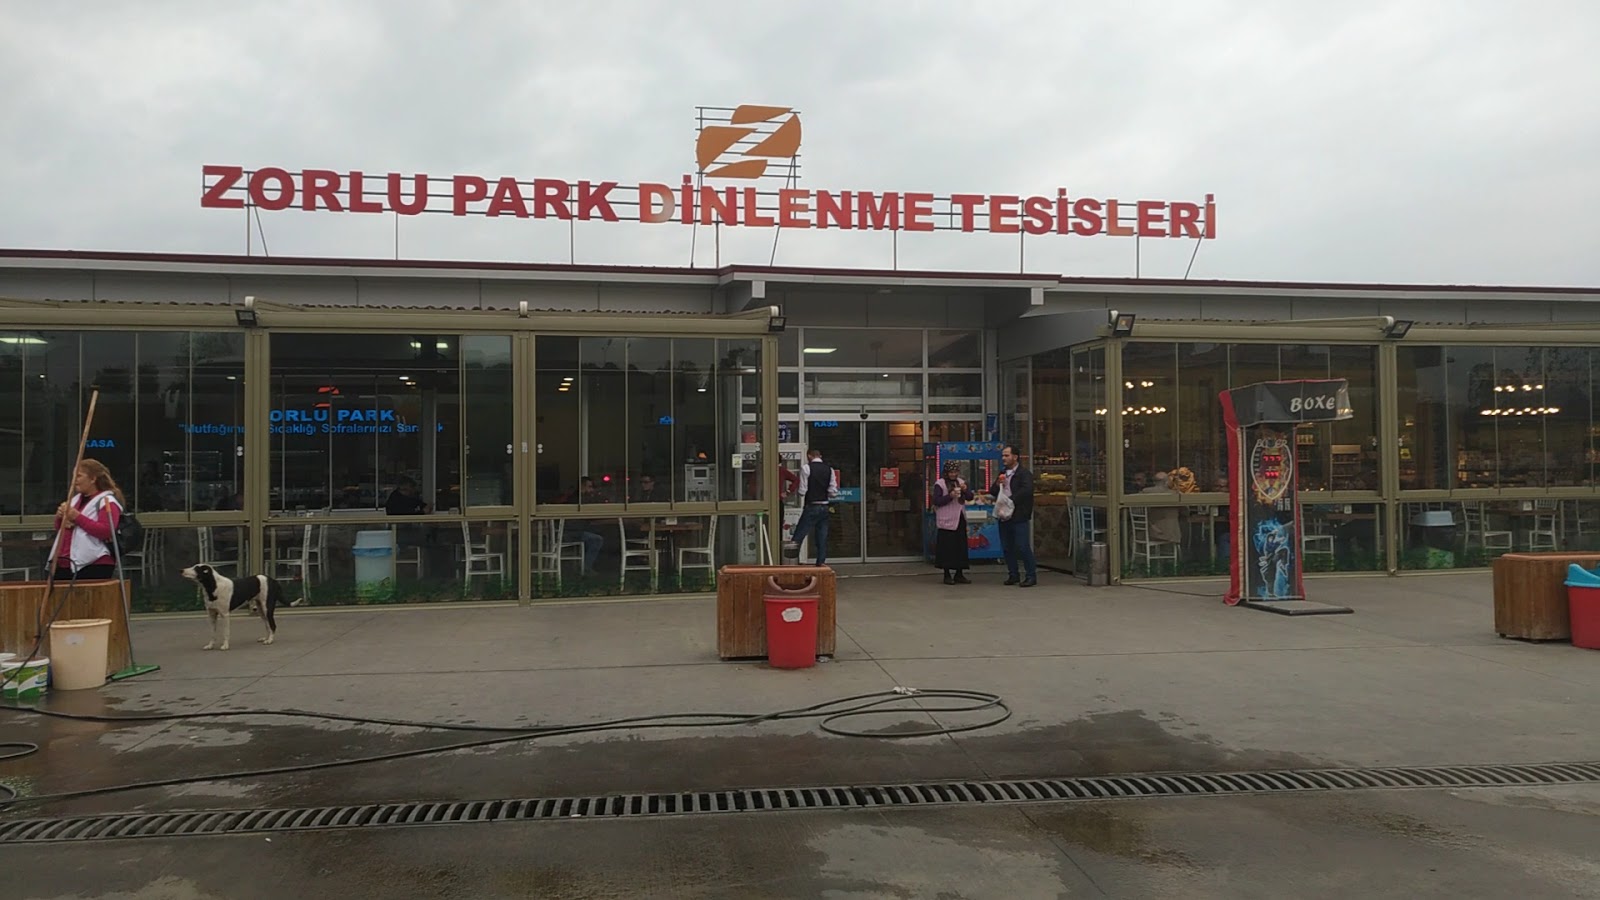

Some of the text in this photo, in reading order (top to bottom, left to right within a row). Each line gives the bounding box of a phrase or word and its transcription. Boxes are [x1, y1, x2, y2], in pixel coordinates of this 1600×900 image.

[200, 164, 1217, 239] ZORLU PARK DİNLENME TESİSLERİ
[269, 408, 396, 422] ORLU PARK
